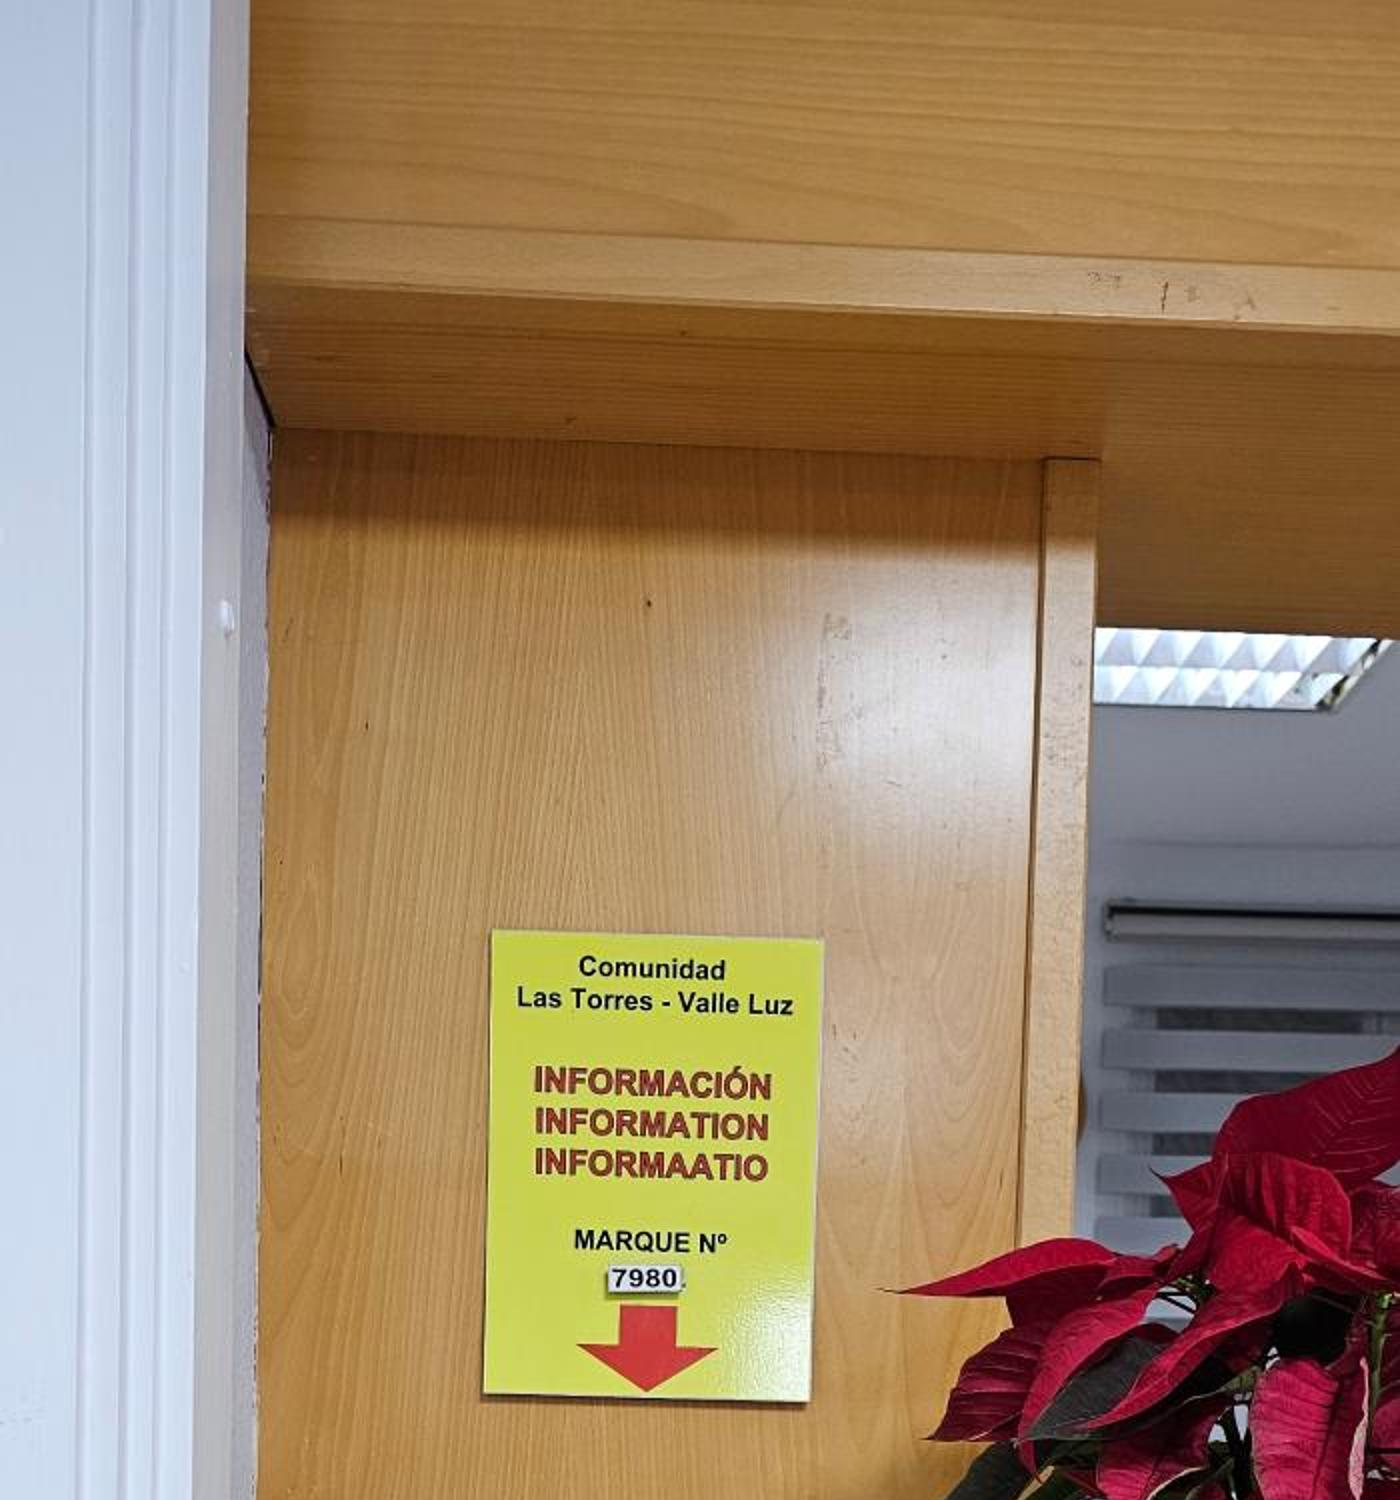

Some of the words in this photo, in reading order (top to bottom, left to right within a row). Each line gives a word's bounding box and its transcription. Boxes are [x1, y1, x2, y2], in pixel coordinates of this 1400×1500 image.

[578, 955, 726, 981] Comunidad
[517, 986, 562, 1009] Las
[570, 988, 653, 1012] Torres
[678, 991, 740, 1014] Valle
[749, 994, 794, 1016] Luz
[534, 1065, 772, 1101] INFORMACIÓN
[535, 1107, 769, 1141] INFORMATION
[535, 1147, 769, 1182] INFORMAATIO
[575, 1229, 690, 1253] MARQUE
